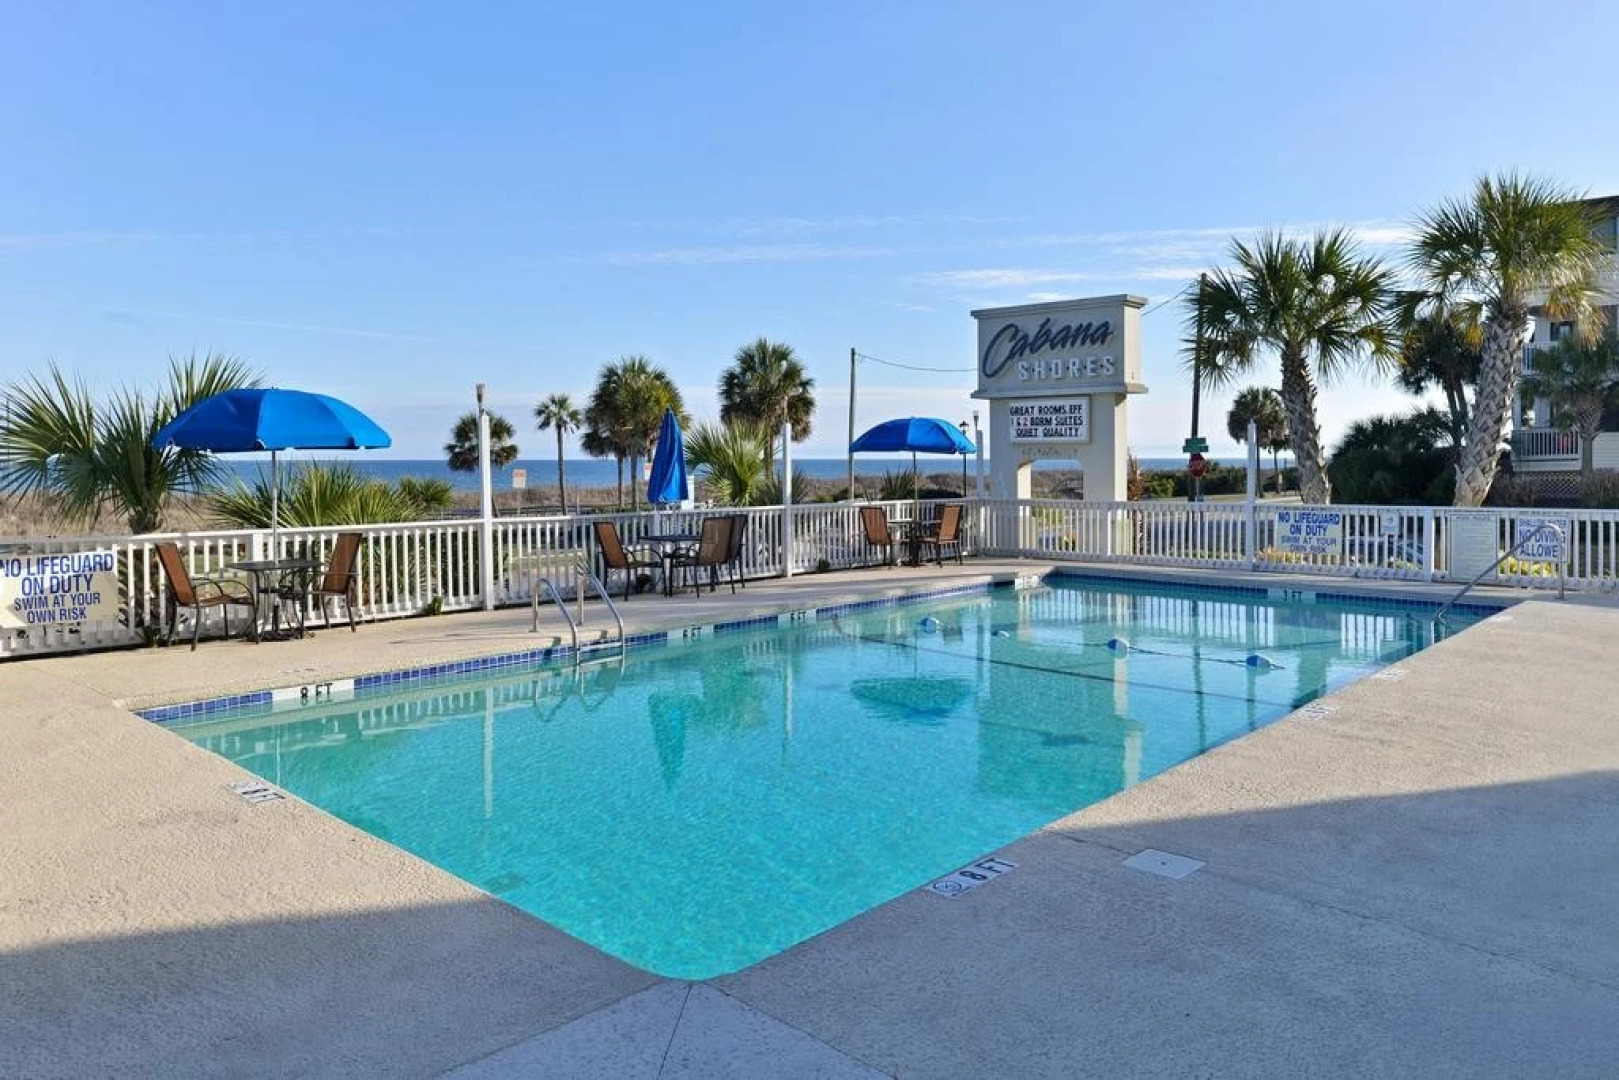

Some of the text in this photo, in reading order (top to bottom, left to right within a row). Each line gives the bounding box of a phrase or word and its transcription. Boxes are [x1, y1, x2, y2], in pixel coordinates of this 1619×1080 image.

[982, 317, 1114, 378] Cabana
[1010, 405, 1035, 416] GREAT
[1055, 415, 1084, 426] SUITES
[1016, 427, 1079, 437] QUIET QUALITY
[1278, 511, 1340, 526] NO LIFEGUARD
[1290, 524, 1328, 536] ON DUTY
[1302, 536, 1312, 545] AT
[1520, 543, 1563, 558] ALLOWE
[0, 553, 114, 577] NO LIFEGUARD
[22, 573, 93, 597] ON DUTY
[14, 592, 100, 611] SWIM AT YOUR
[26, 606, 87, 623] OWN RISK
[300, 682, 333, 698] 8 FT
[959, 858, 1015, 881] 8 FT
